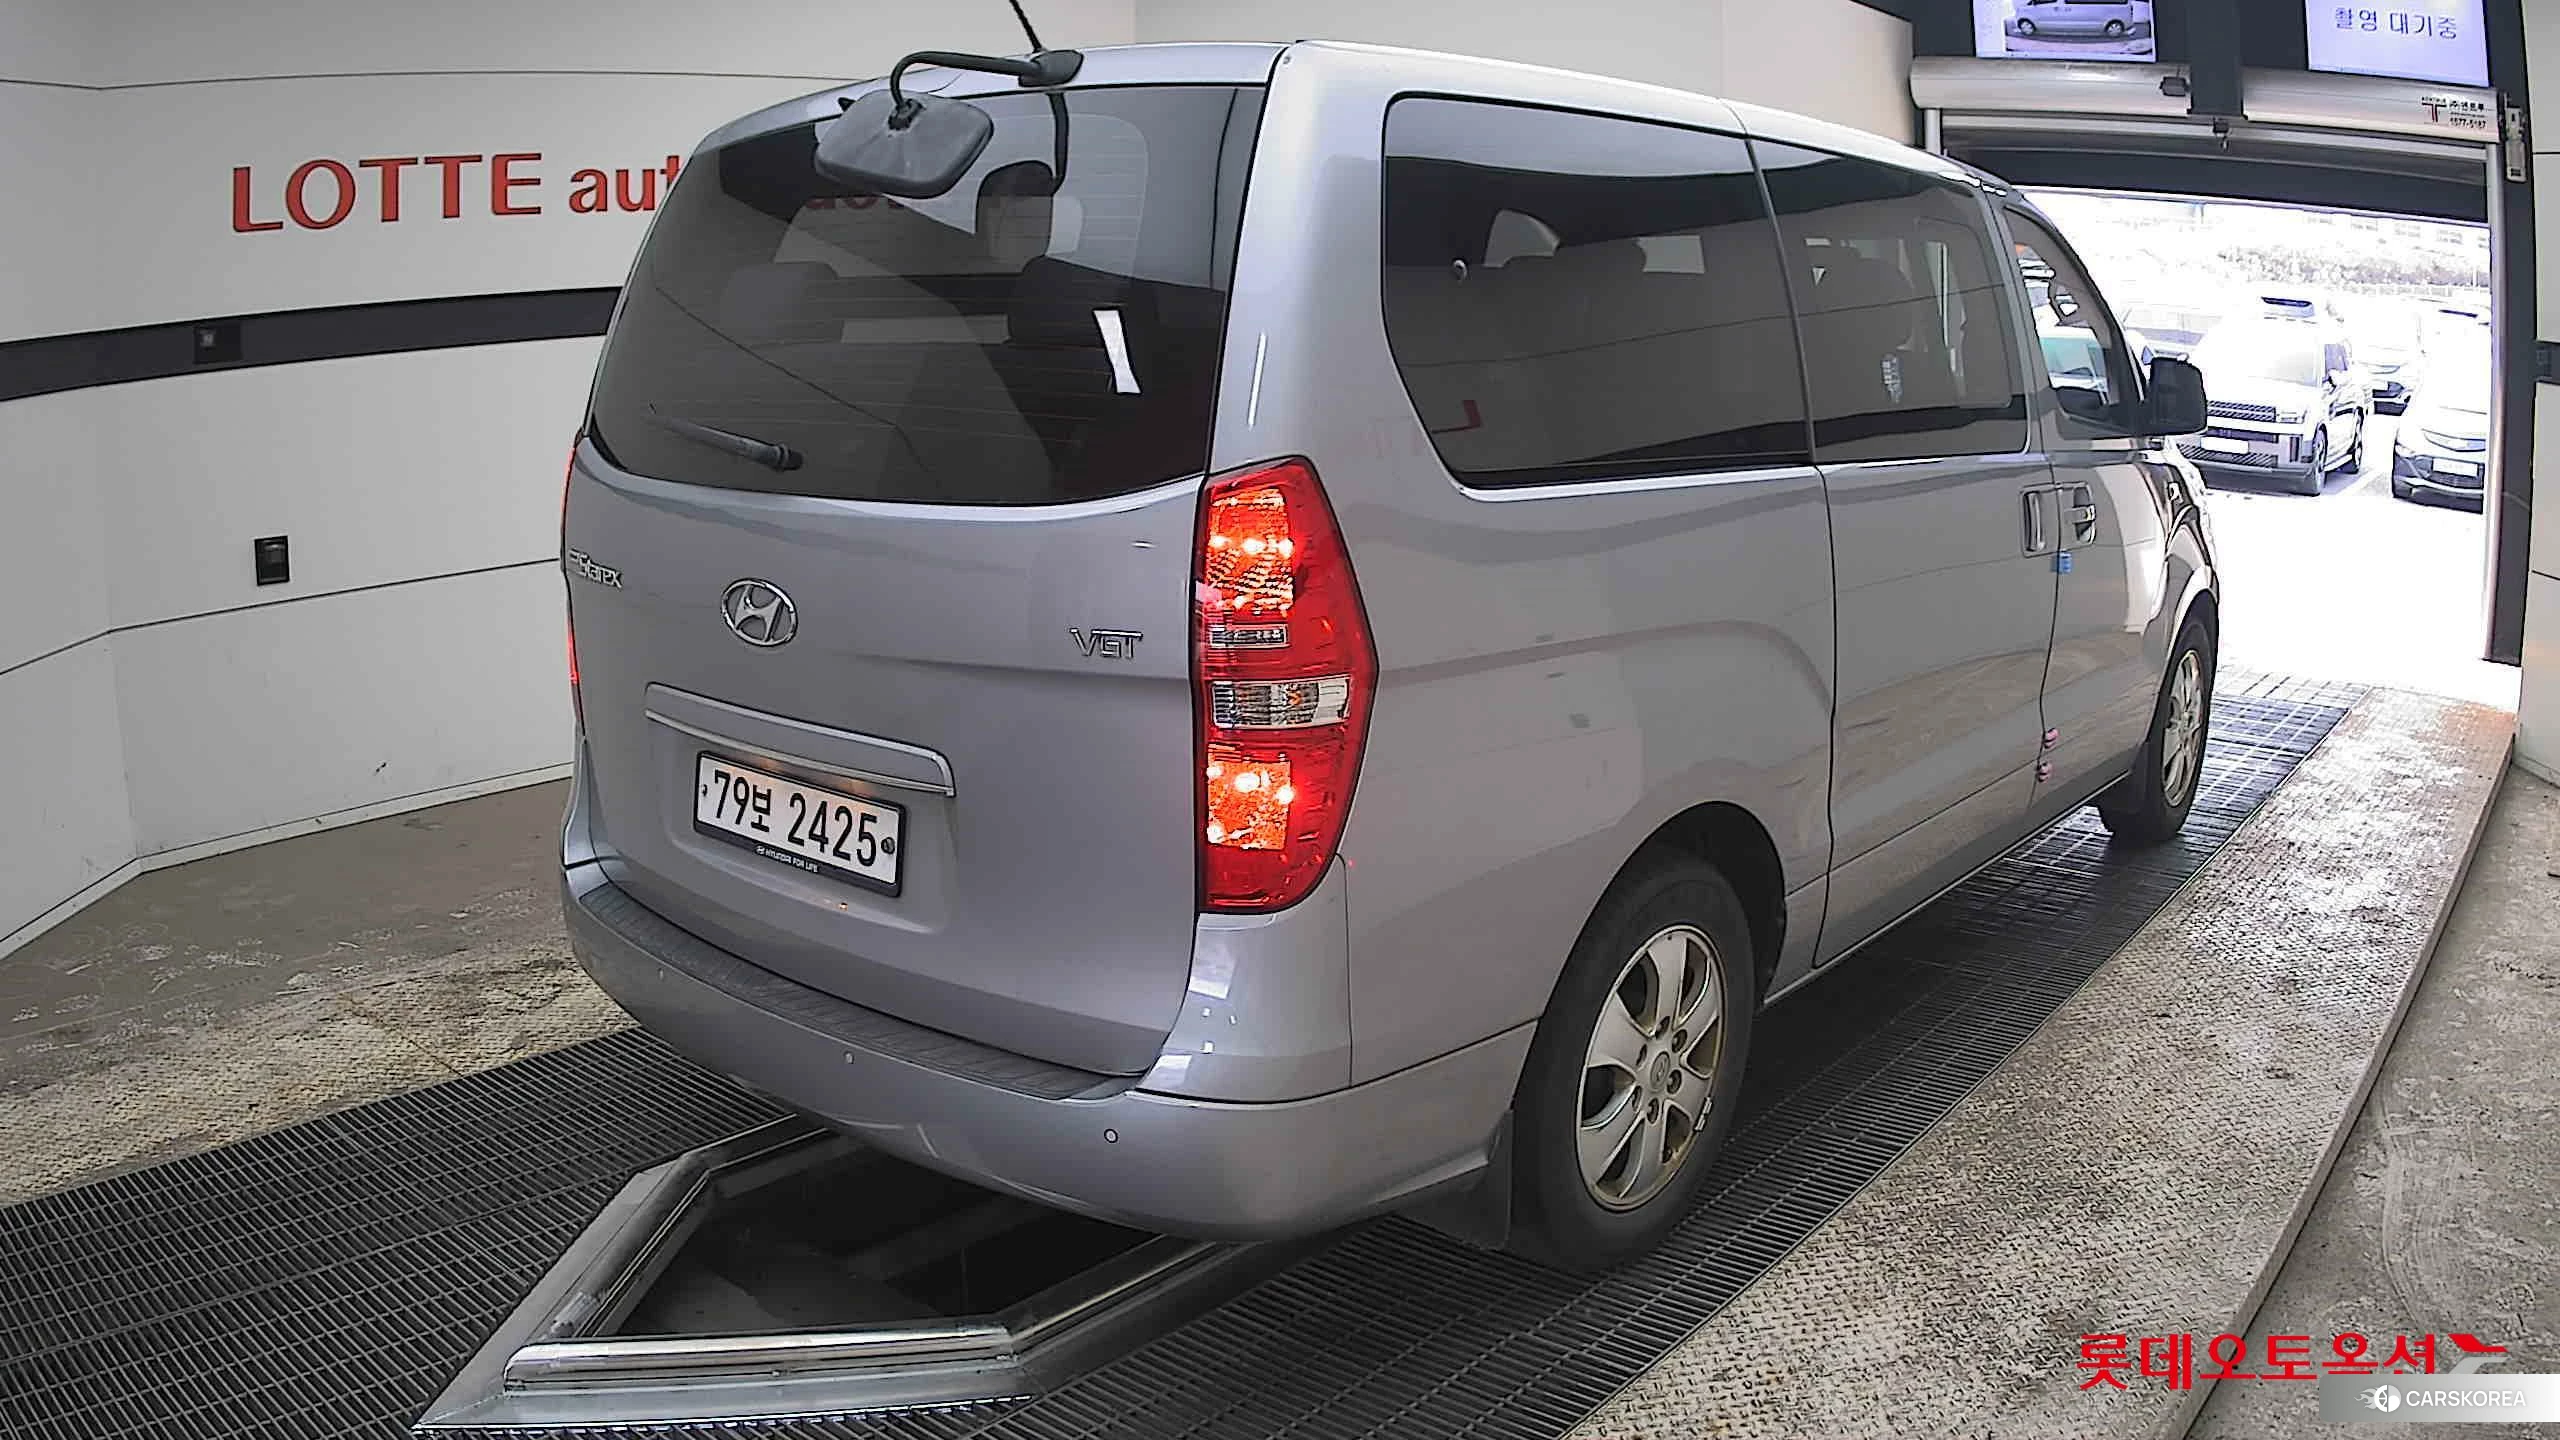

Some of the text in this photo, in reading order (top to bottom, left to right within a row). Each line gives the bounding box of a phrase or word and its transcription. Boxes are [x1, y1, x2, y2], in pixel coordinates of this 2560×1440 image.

[2335, 7, 2458, 40] 촬영 대기중
[232, 152, 683, 233] LOTTE aut
[1069, 627, 1144, 659] VGT
[713, 768, 877, 867] 79보 2425
